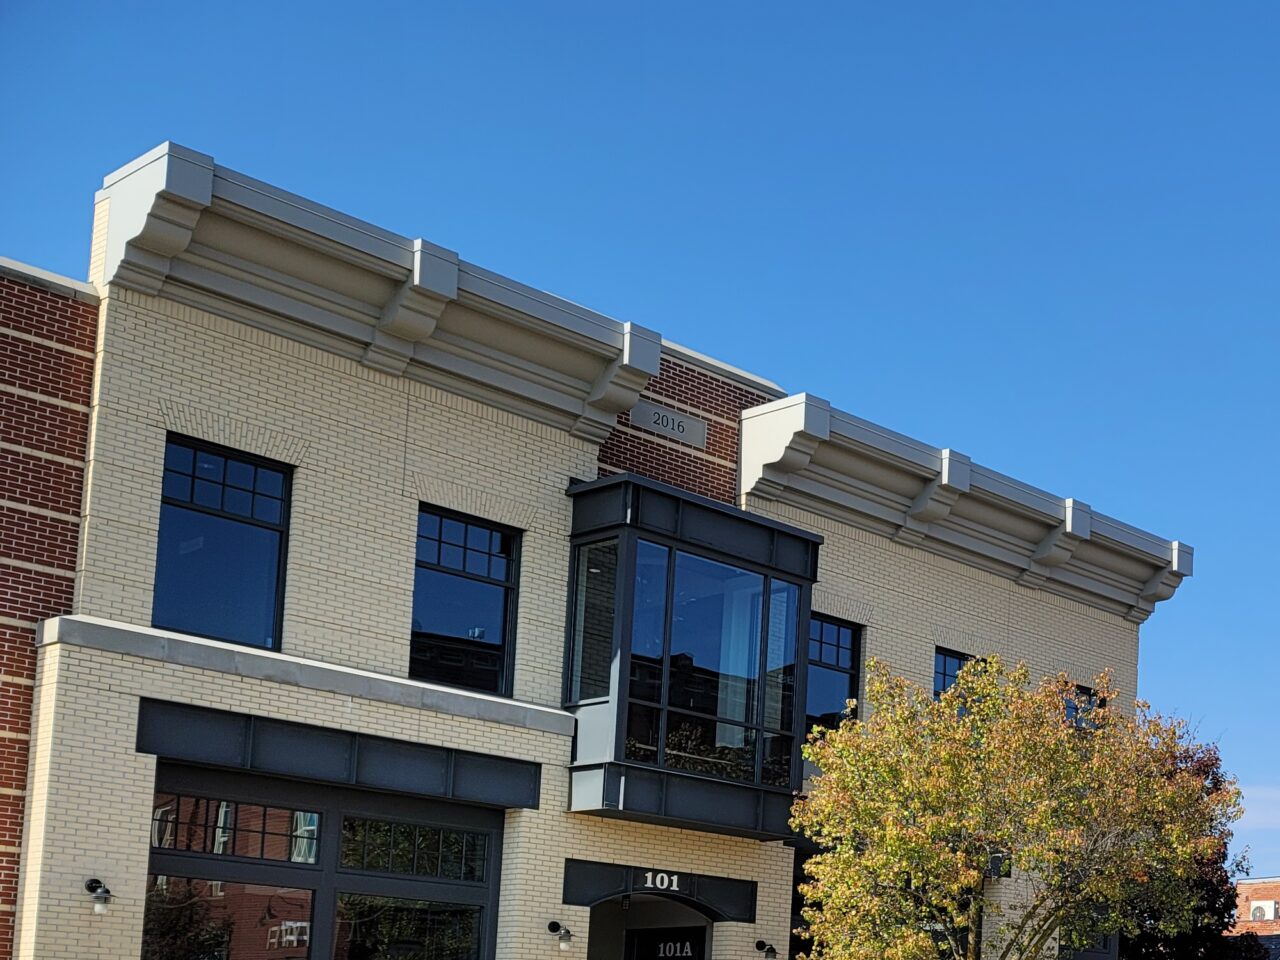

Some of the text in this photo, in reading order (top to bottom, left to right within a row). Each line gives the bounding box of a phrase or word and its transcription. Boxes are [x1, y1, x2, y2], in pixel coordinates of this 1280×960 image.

[652, 411, 685, 434] 2016
[644, 871, 680, 891] 101
[658, 941, 692, 957] 101A
